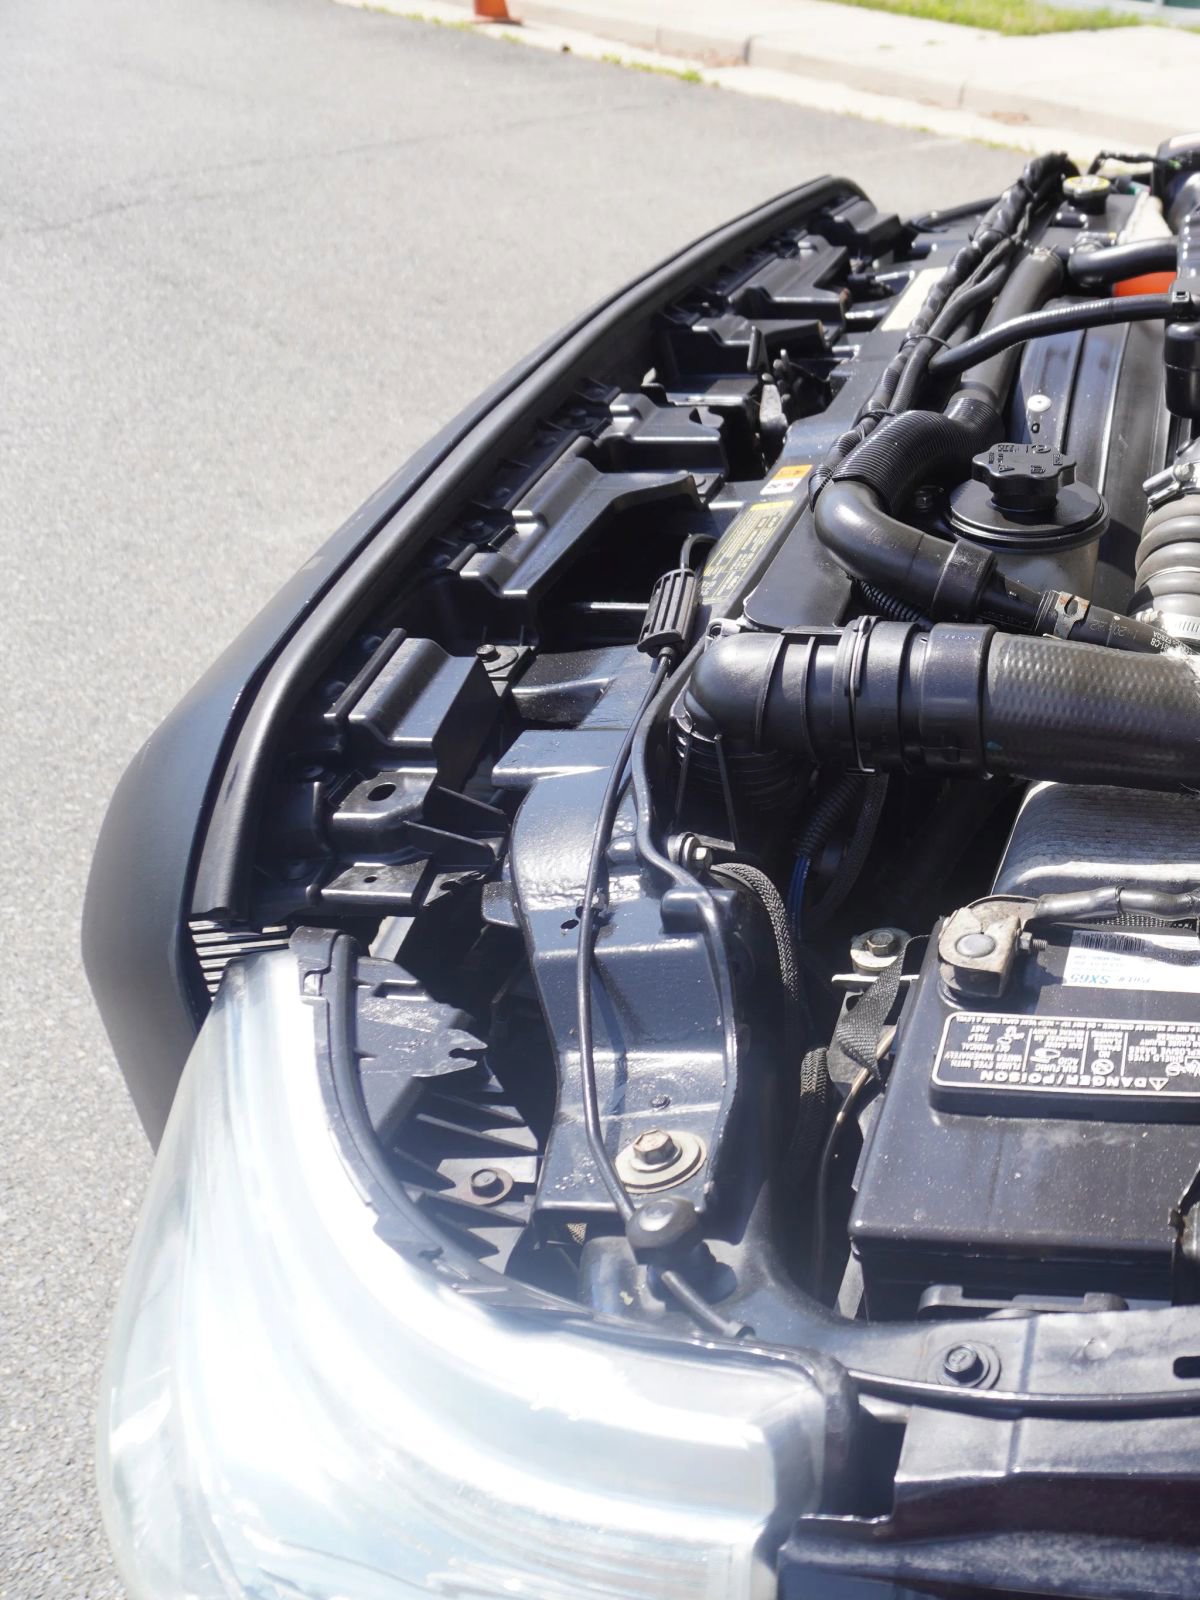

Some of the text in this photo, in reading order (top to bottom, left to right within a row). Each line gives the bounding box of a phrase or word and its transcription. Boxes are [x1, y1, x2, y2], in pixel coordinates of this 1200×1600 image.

[1070, 974, 1111, 985] SX65
[970, 1025, 990, 1033] FAST
[968, 1033, 988, 1041] HELP
[961, 1042, 1010, 1052] GET MEDICAL
[1129, 1046, 1157, 1054] GASES
[944, 1051, 1022, 1062] WATER IMMEDIATELY
[1128, 1053, 1184, 1063] SHIELD EYES
[973, 1061, 994, 1069] EYES
[1058, 1057, 1079, 1065] ACID
[995, 1062, 1021, 1070] FLUSH
[1035, 1064, 1078, 1073] SULFURIC
[980, 1070, 1148, 1087] DANGER/POISON
